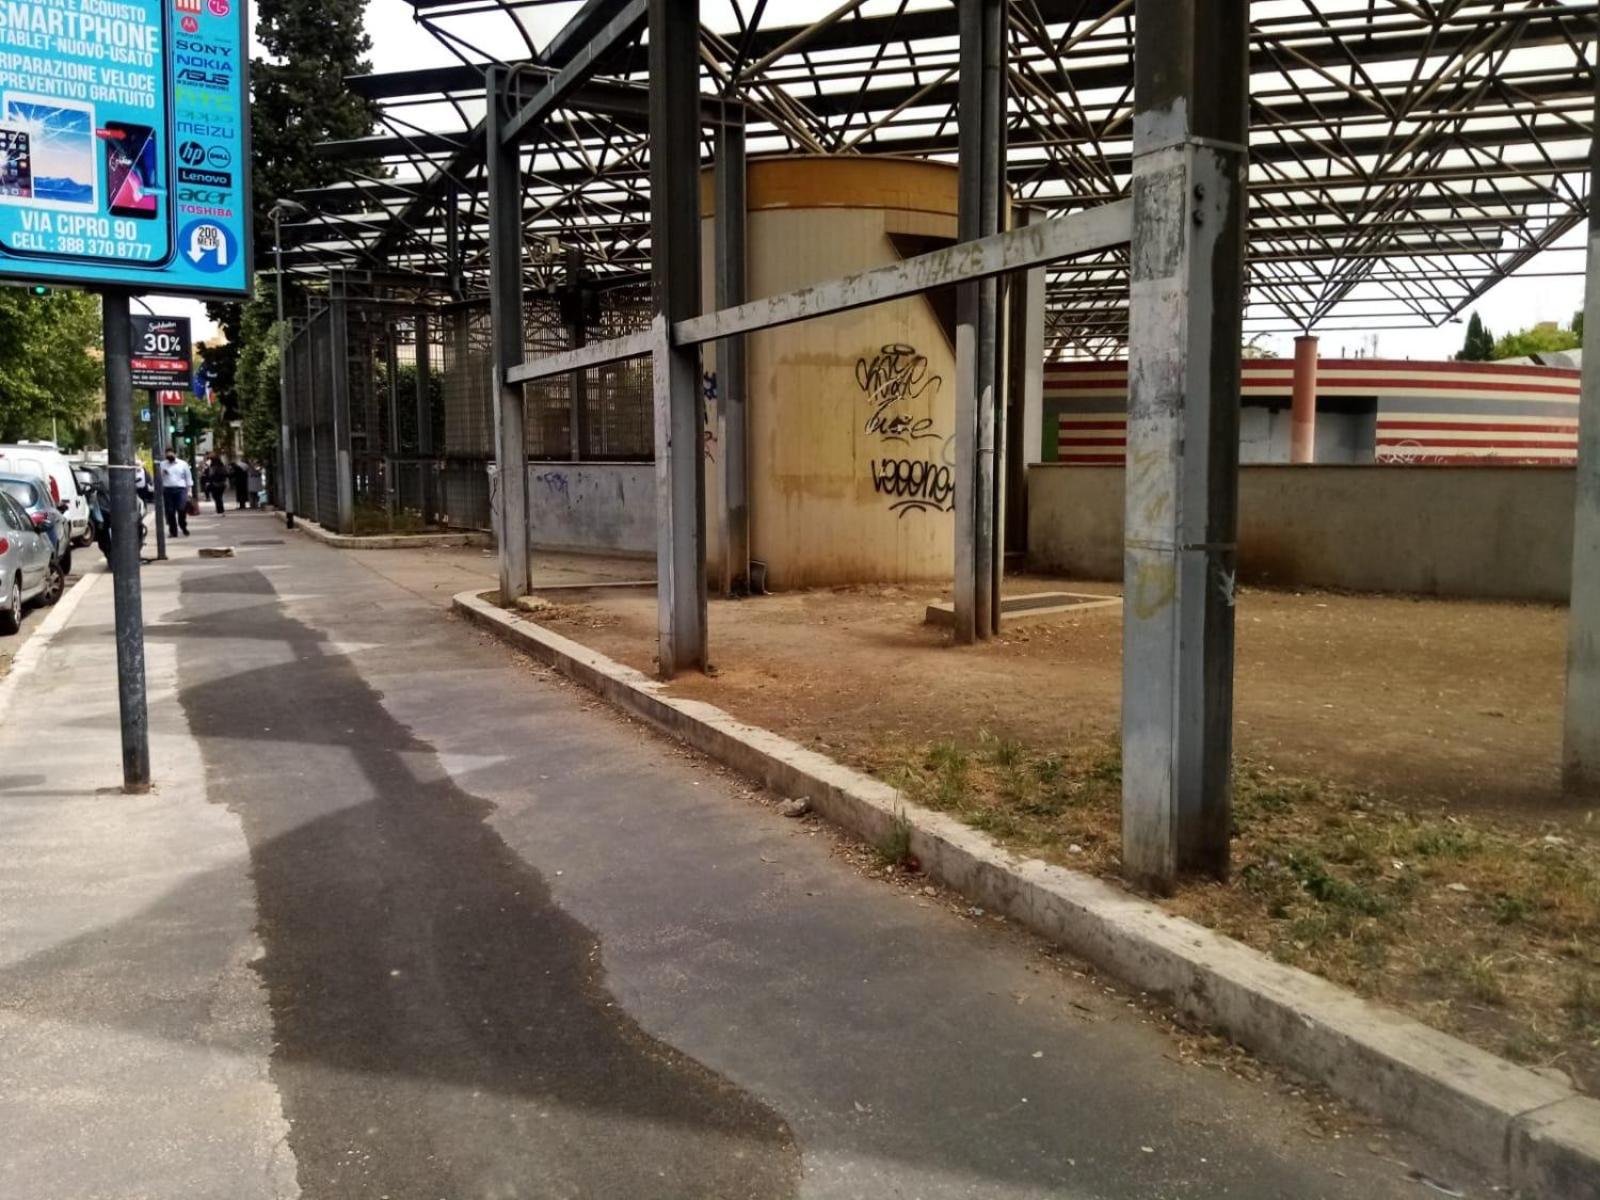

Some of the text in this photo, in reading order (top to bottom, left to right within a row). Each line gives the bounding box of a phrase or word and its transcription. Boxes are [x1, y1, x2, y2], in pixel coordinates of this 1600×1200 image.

[80, 0, 146, 23] ACQUISTO
[176, 40, 232, 56] SONY
[177, 55, 233, 71] NOKIA
[0, 52, 155, 92] RIPARAZIONE VELOCE
[177, 69, 229, 85] ASUS
[0, 71, 86, 99] PREVENTIVO
[90, 84, 155, 109] GRATUITO
[182, 170, 227, 184] Lenovo
[178, 188, 232, 205] acer
[179, 204, 232, 218] TOSHIBA
[21, 210, 137, 241] VIA CIPRO 90
[198, 226, 217, 239] 200
[58, 236, 85, 253] 388
[88, 239, 114, 256] 370
[117, 241, 152, 259] 8777
[143, 333, 181, 352] 30%
